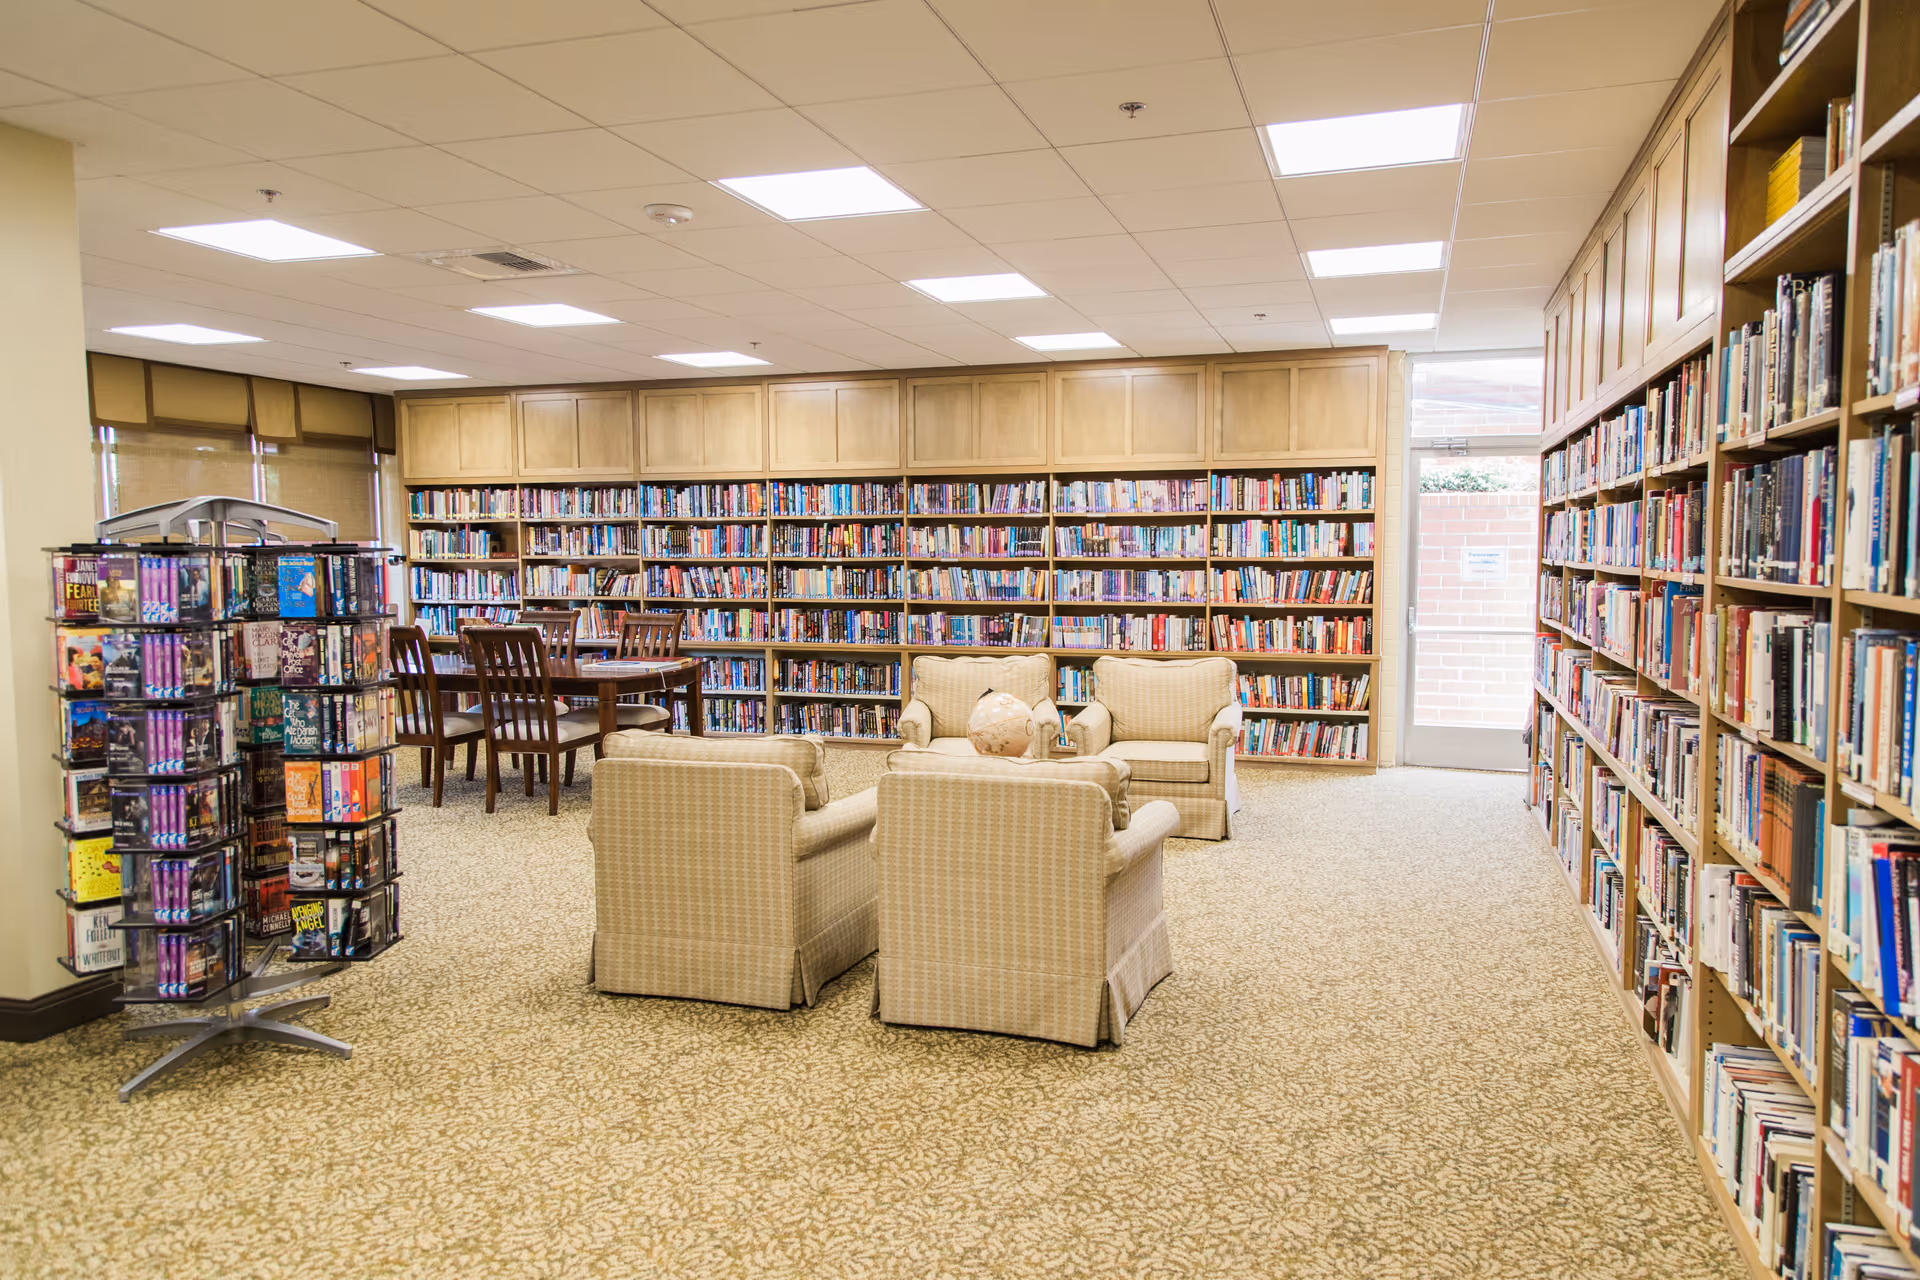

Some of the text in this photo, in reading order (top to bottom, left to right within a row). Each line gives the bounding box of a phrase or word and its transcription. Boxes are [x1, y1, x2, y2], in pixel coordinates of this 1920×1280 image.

[66, 584, 96, 599] FEARL
[67, 599, 99, 612] FOURTEE
[290, 717, 305, 728] Who
[297, 725, 318, 737] Danish
[263, 912, 290, 924] MICHAEL
[291, 901, 324, 921] AVENGING
[93, 914, 110, 929] KEN
[262, 920, 291, 933] CONNELLY
[296, 916, 325, 935] ANGEL
[82, 948, 120, 966] WHITEOUT
